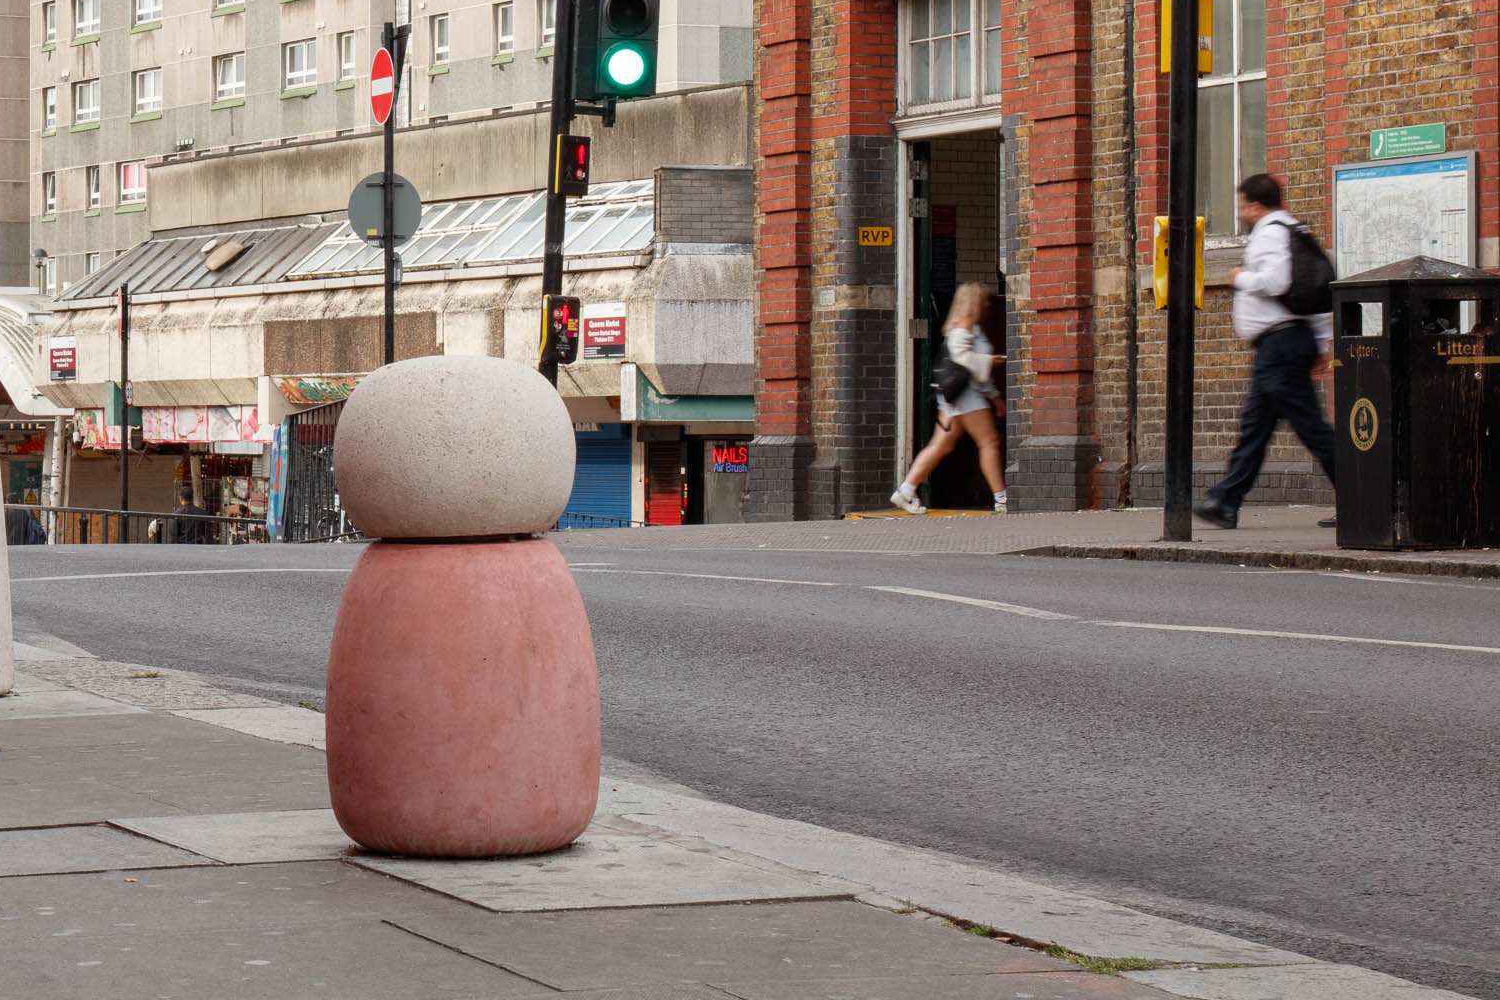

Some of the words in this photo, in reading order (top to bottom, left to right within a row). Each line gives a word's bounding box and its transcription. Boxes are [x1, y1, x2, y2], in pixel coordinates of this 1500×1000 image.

[861, 230, 891, 243] RVP
[1436, 340, 1479, 357] Litter
[712, 447, 748, 464] NAILS
[713, 463, 724, 473] Air
[725, 463, 748, 473] Brush
